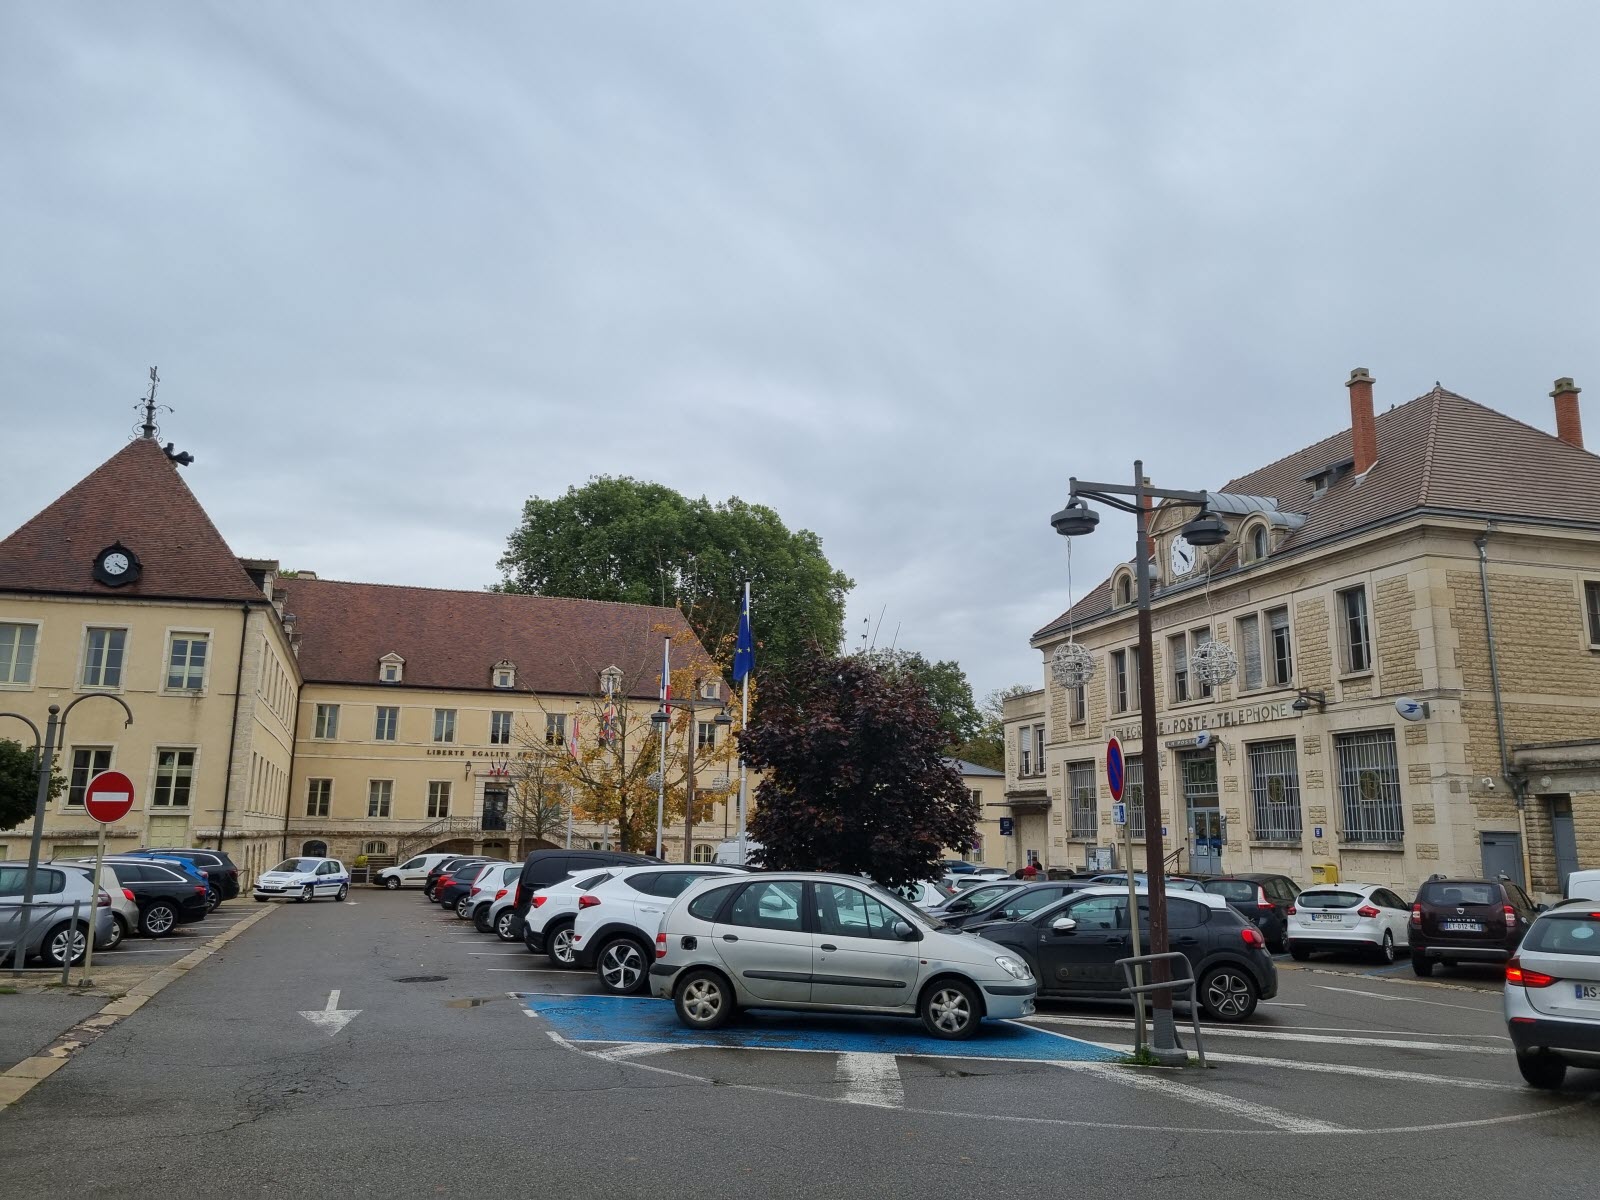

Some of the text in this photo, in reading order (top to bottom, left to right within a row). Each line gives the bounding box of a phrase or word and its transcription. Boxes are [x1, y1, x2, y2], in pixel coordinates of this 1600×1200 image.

[1173, 715, 1208, 731] POSTE
[1217, 703, 1288, 727] TELEPHONE
[426, 749, 465, 757] LIBERTE
[472, 750, 510, 758] EGALITE
